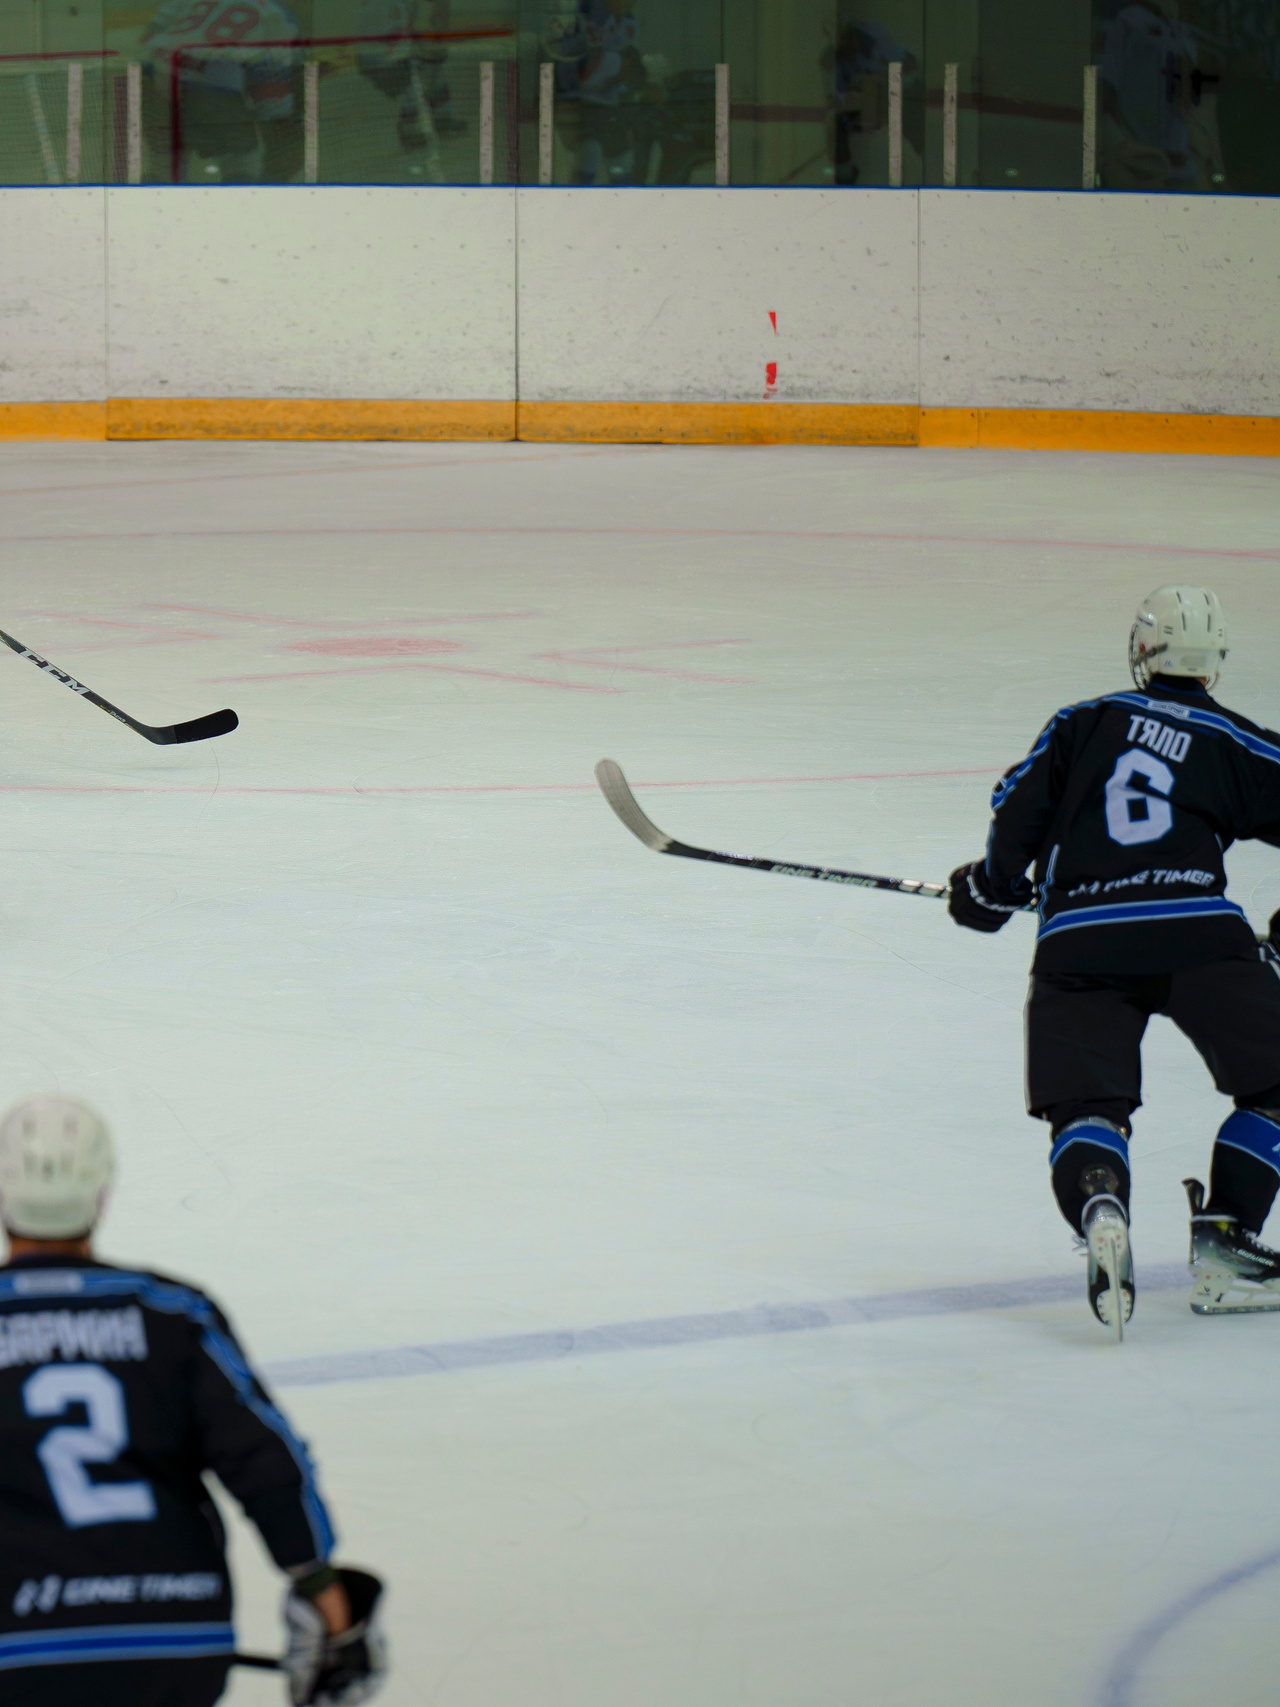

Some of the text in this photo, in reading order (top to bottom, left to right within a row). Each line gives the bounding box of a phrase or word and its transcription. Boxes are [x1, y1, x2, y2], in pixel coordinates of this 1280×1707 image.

[20, 646, 91, 696] CCM
[1127, 714, 1192, 764] ТЯЛО
[1104, 747, 1176, 848] 6
[1151, 868, 1217, 888] TIMER
[22, 1361, 158, 1527] 2
